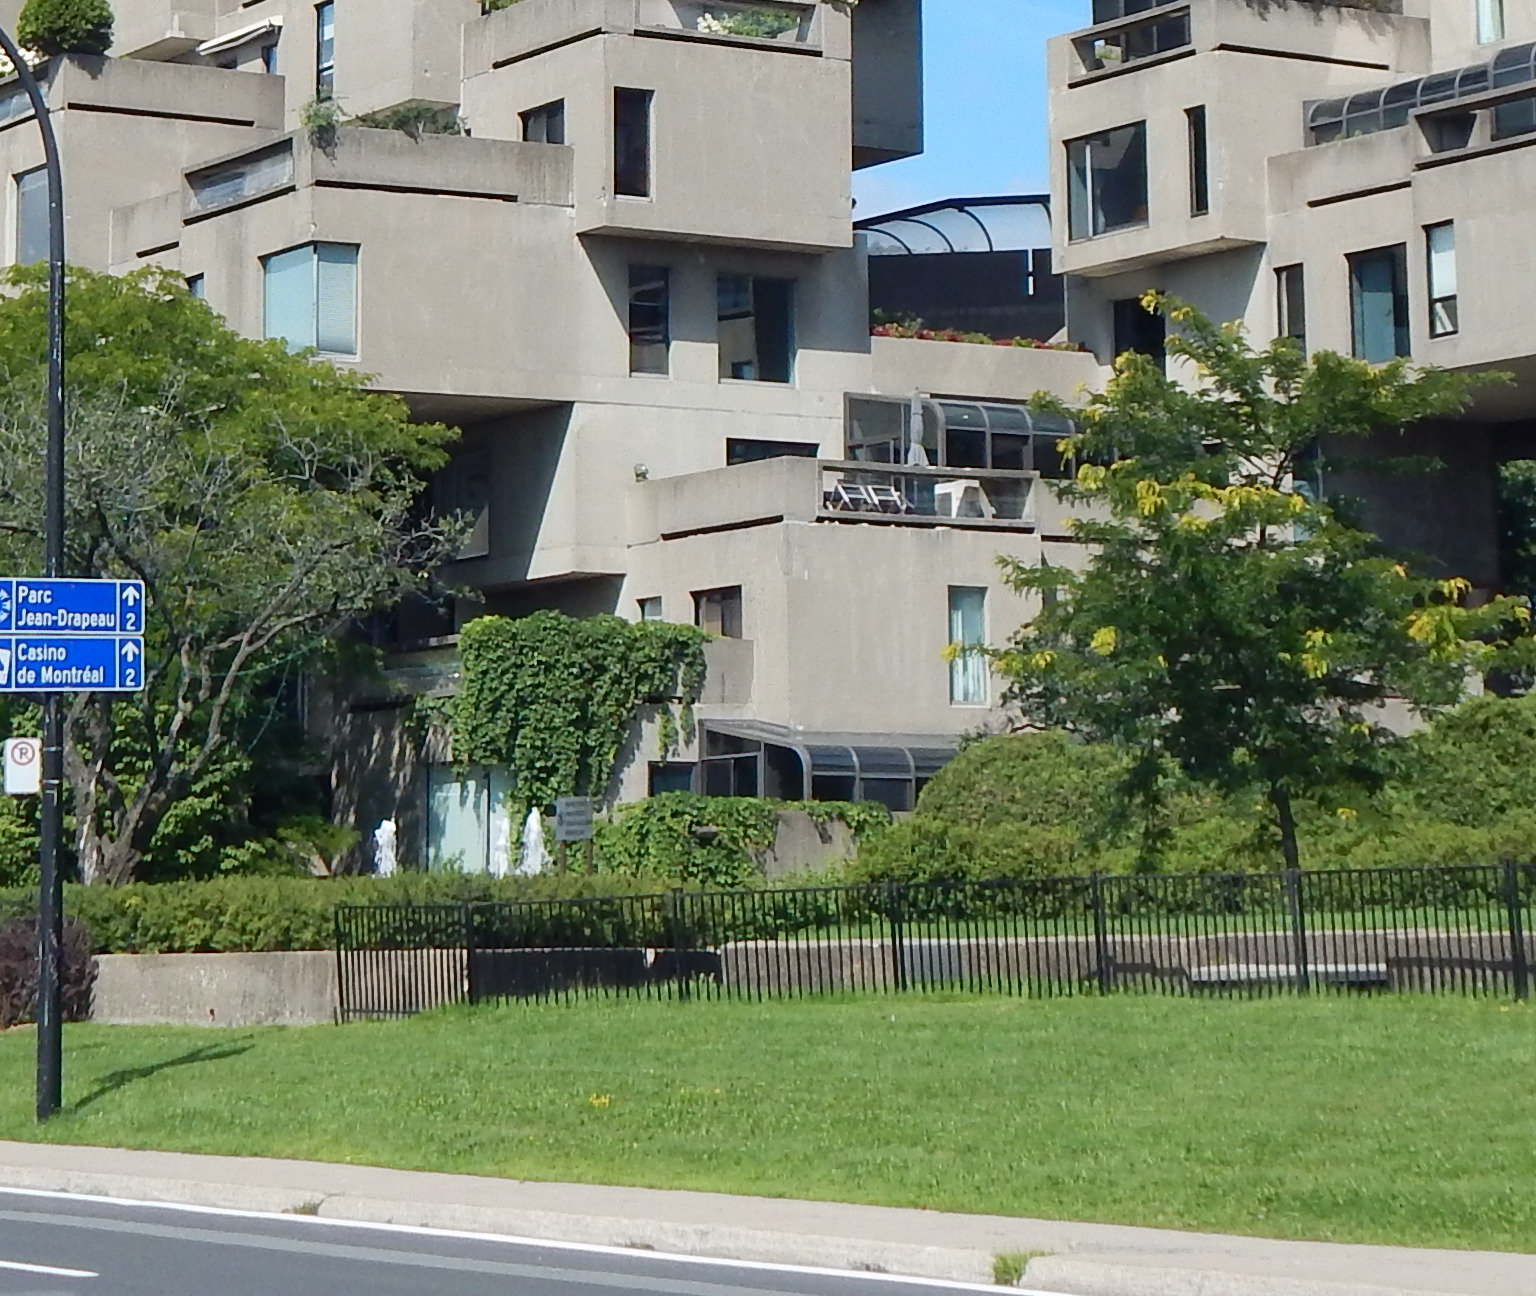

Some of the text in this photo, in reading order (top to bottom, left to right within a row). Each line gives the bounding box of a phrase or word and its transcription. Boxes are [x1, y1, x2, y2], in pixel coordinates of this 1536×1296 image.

[18, 585, 52, 604] Parc
[17, 608, 115, 630] Jean-Drapeau
[125, 612, 136, 630] 2
[17, 643, 66, 661] Casino
[17, 665, 104, 683] de Montréal
[125, 669, 136, 686] 2
